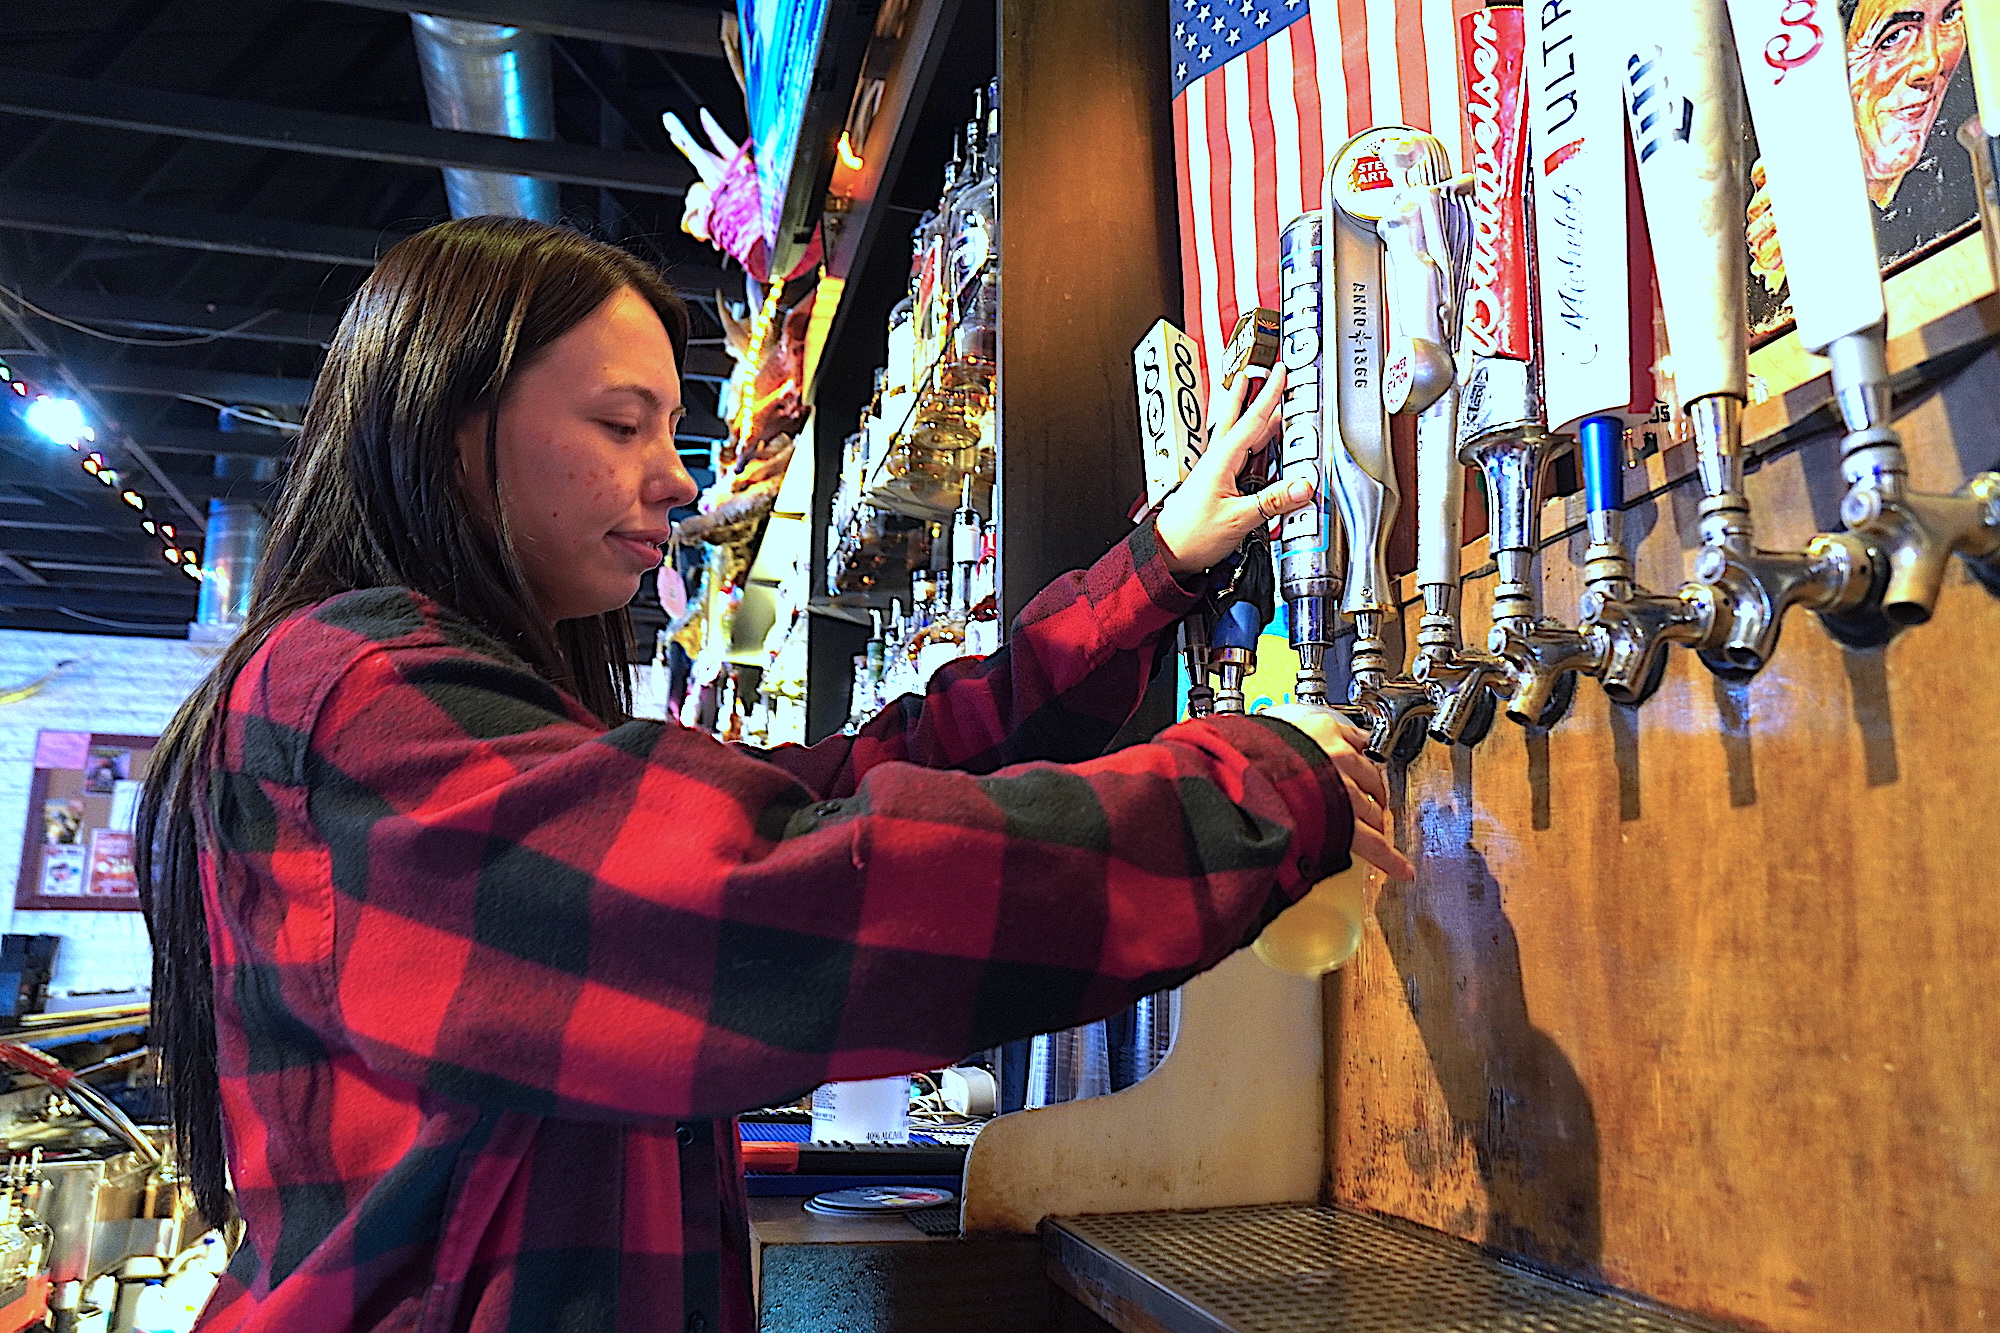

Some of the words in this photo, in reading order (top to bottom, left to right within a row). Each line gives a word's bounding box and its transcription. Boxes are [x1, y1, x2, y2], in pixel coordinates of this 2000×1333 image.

[1462, 8, 1502, 370] Budweiser
[1281, 257, 1320, 419] LIGHT
[1352, 282, 1368, 327] ANNO
[1552, 183, 1597, 364] Michelob
[1353, 347, 1369, 389] 1366
